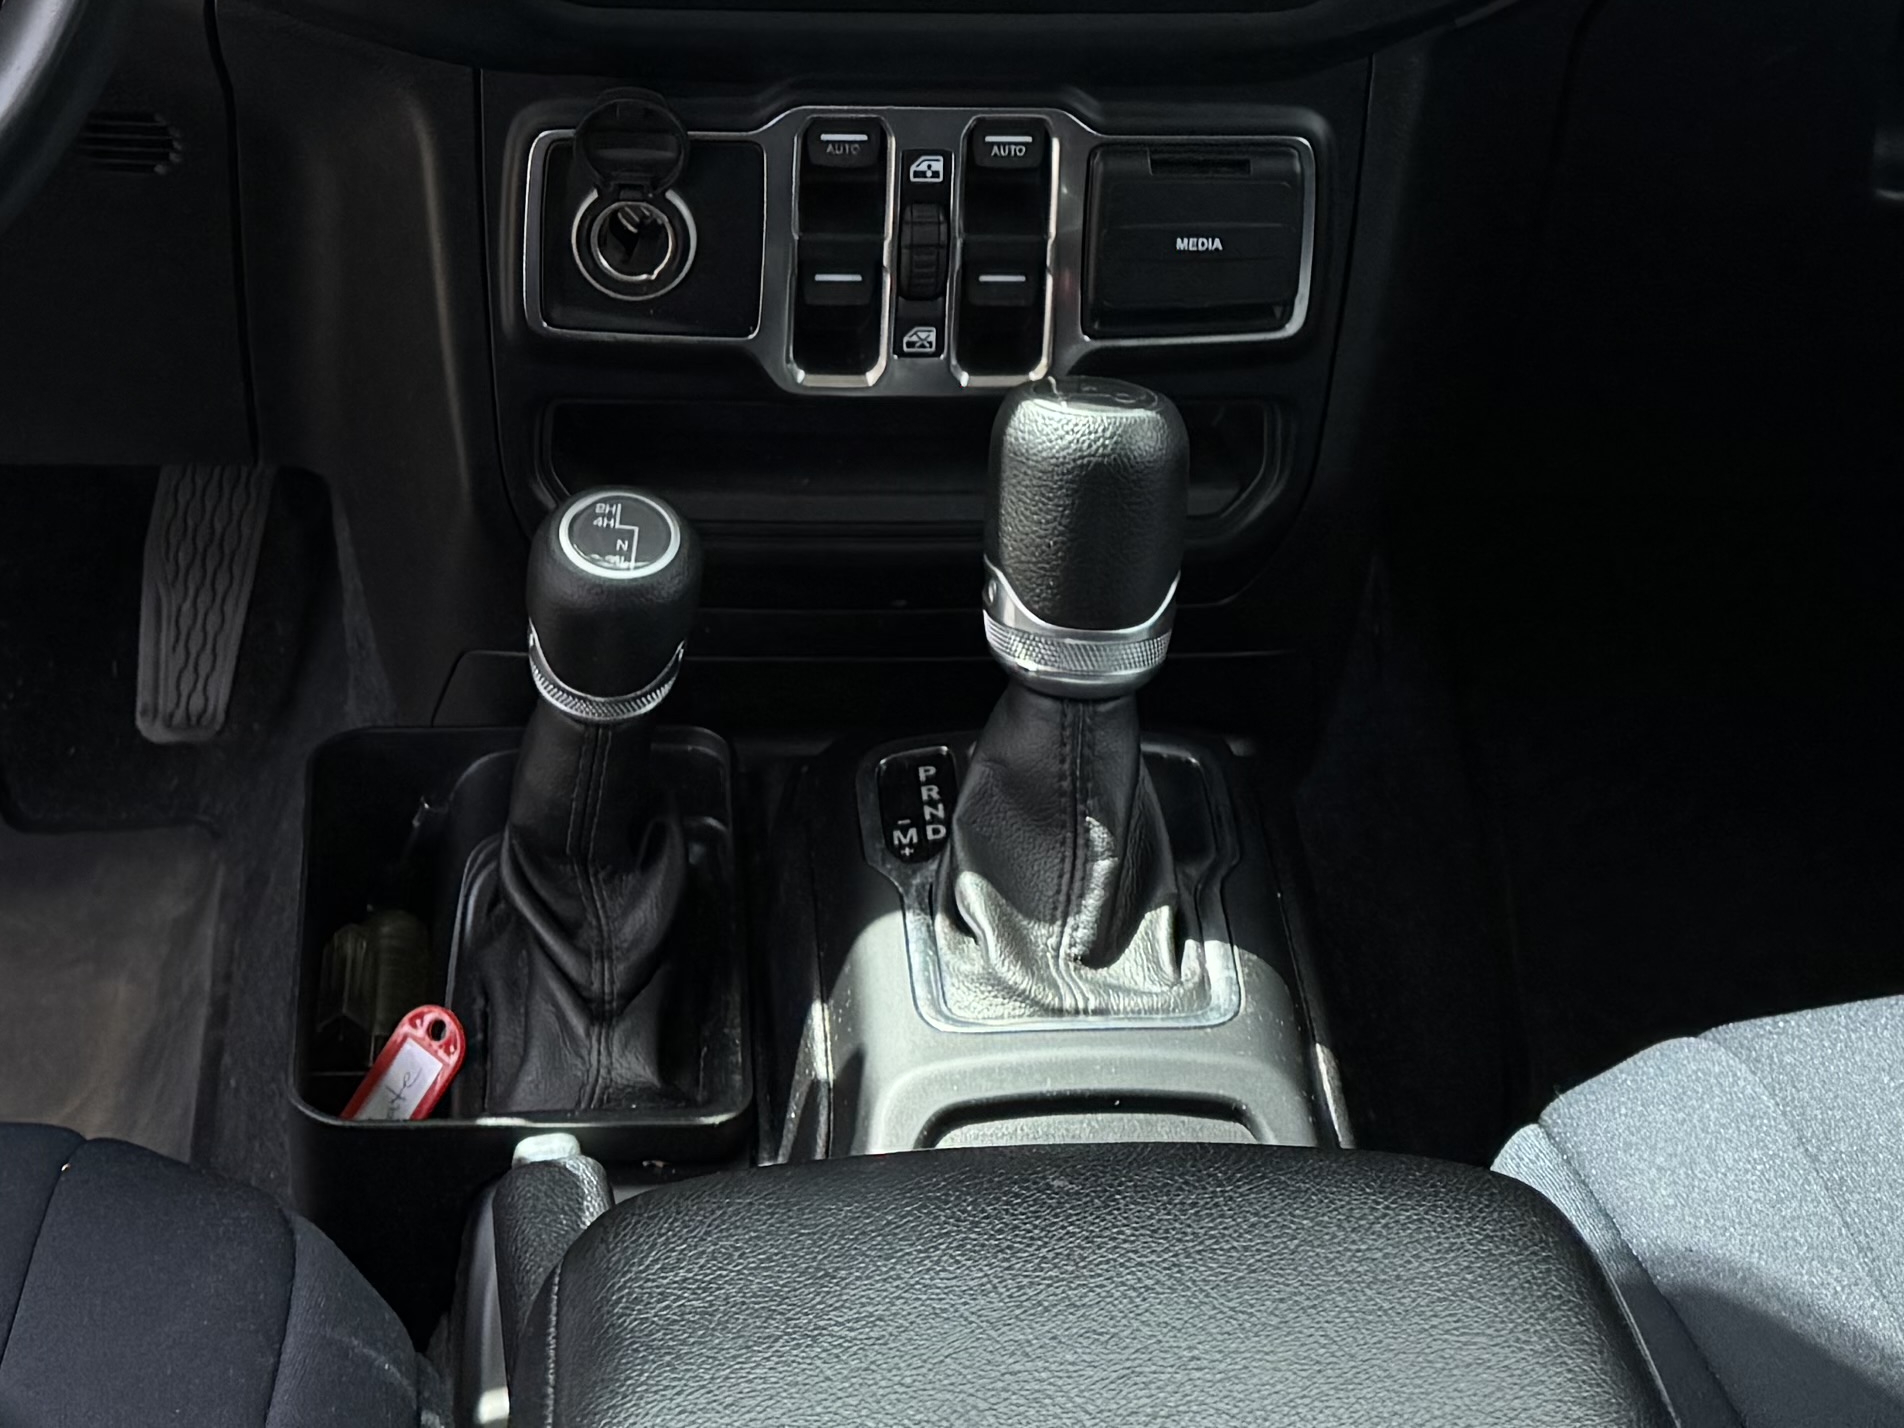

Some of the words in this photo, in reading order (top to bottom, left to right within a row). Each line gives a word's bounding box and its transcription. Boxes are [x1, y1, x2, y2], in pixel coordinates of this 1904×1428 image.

[826, 143, 861, 156] AUTO
[990, 144, 1026, 157] AUTO
[1174, 235, 1224, 253] MEDIA
[592, 516, 615, 528] 4H
[615, 538, 629, 552] N
[917, 765, 937, 782] P
[920, 785, 942, 802] R
[923, 803, 946, 821] N
[925, 824, 947, 840] D
